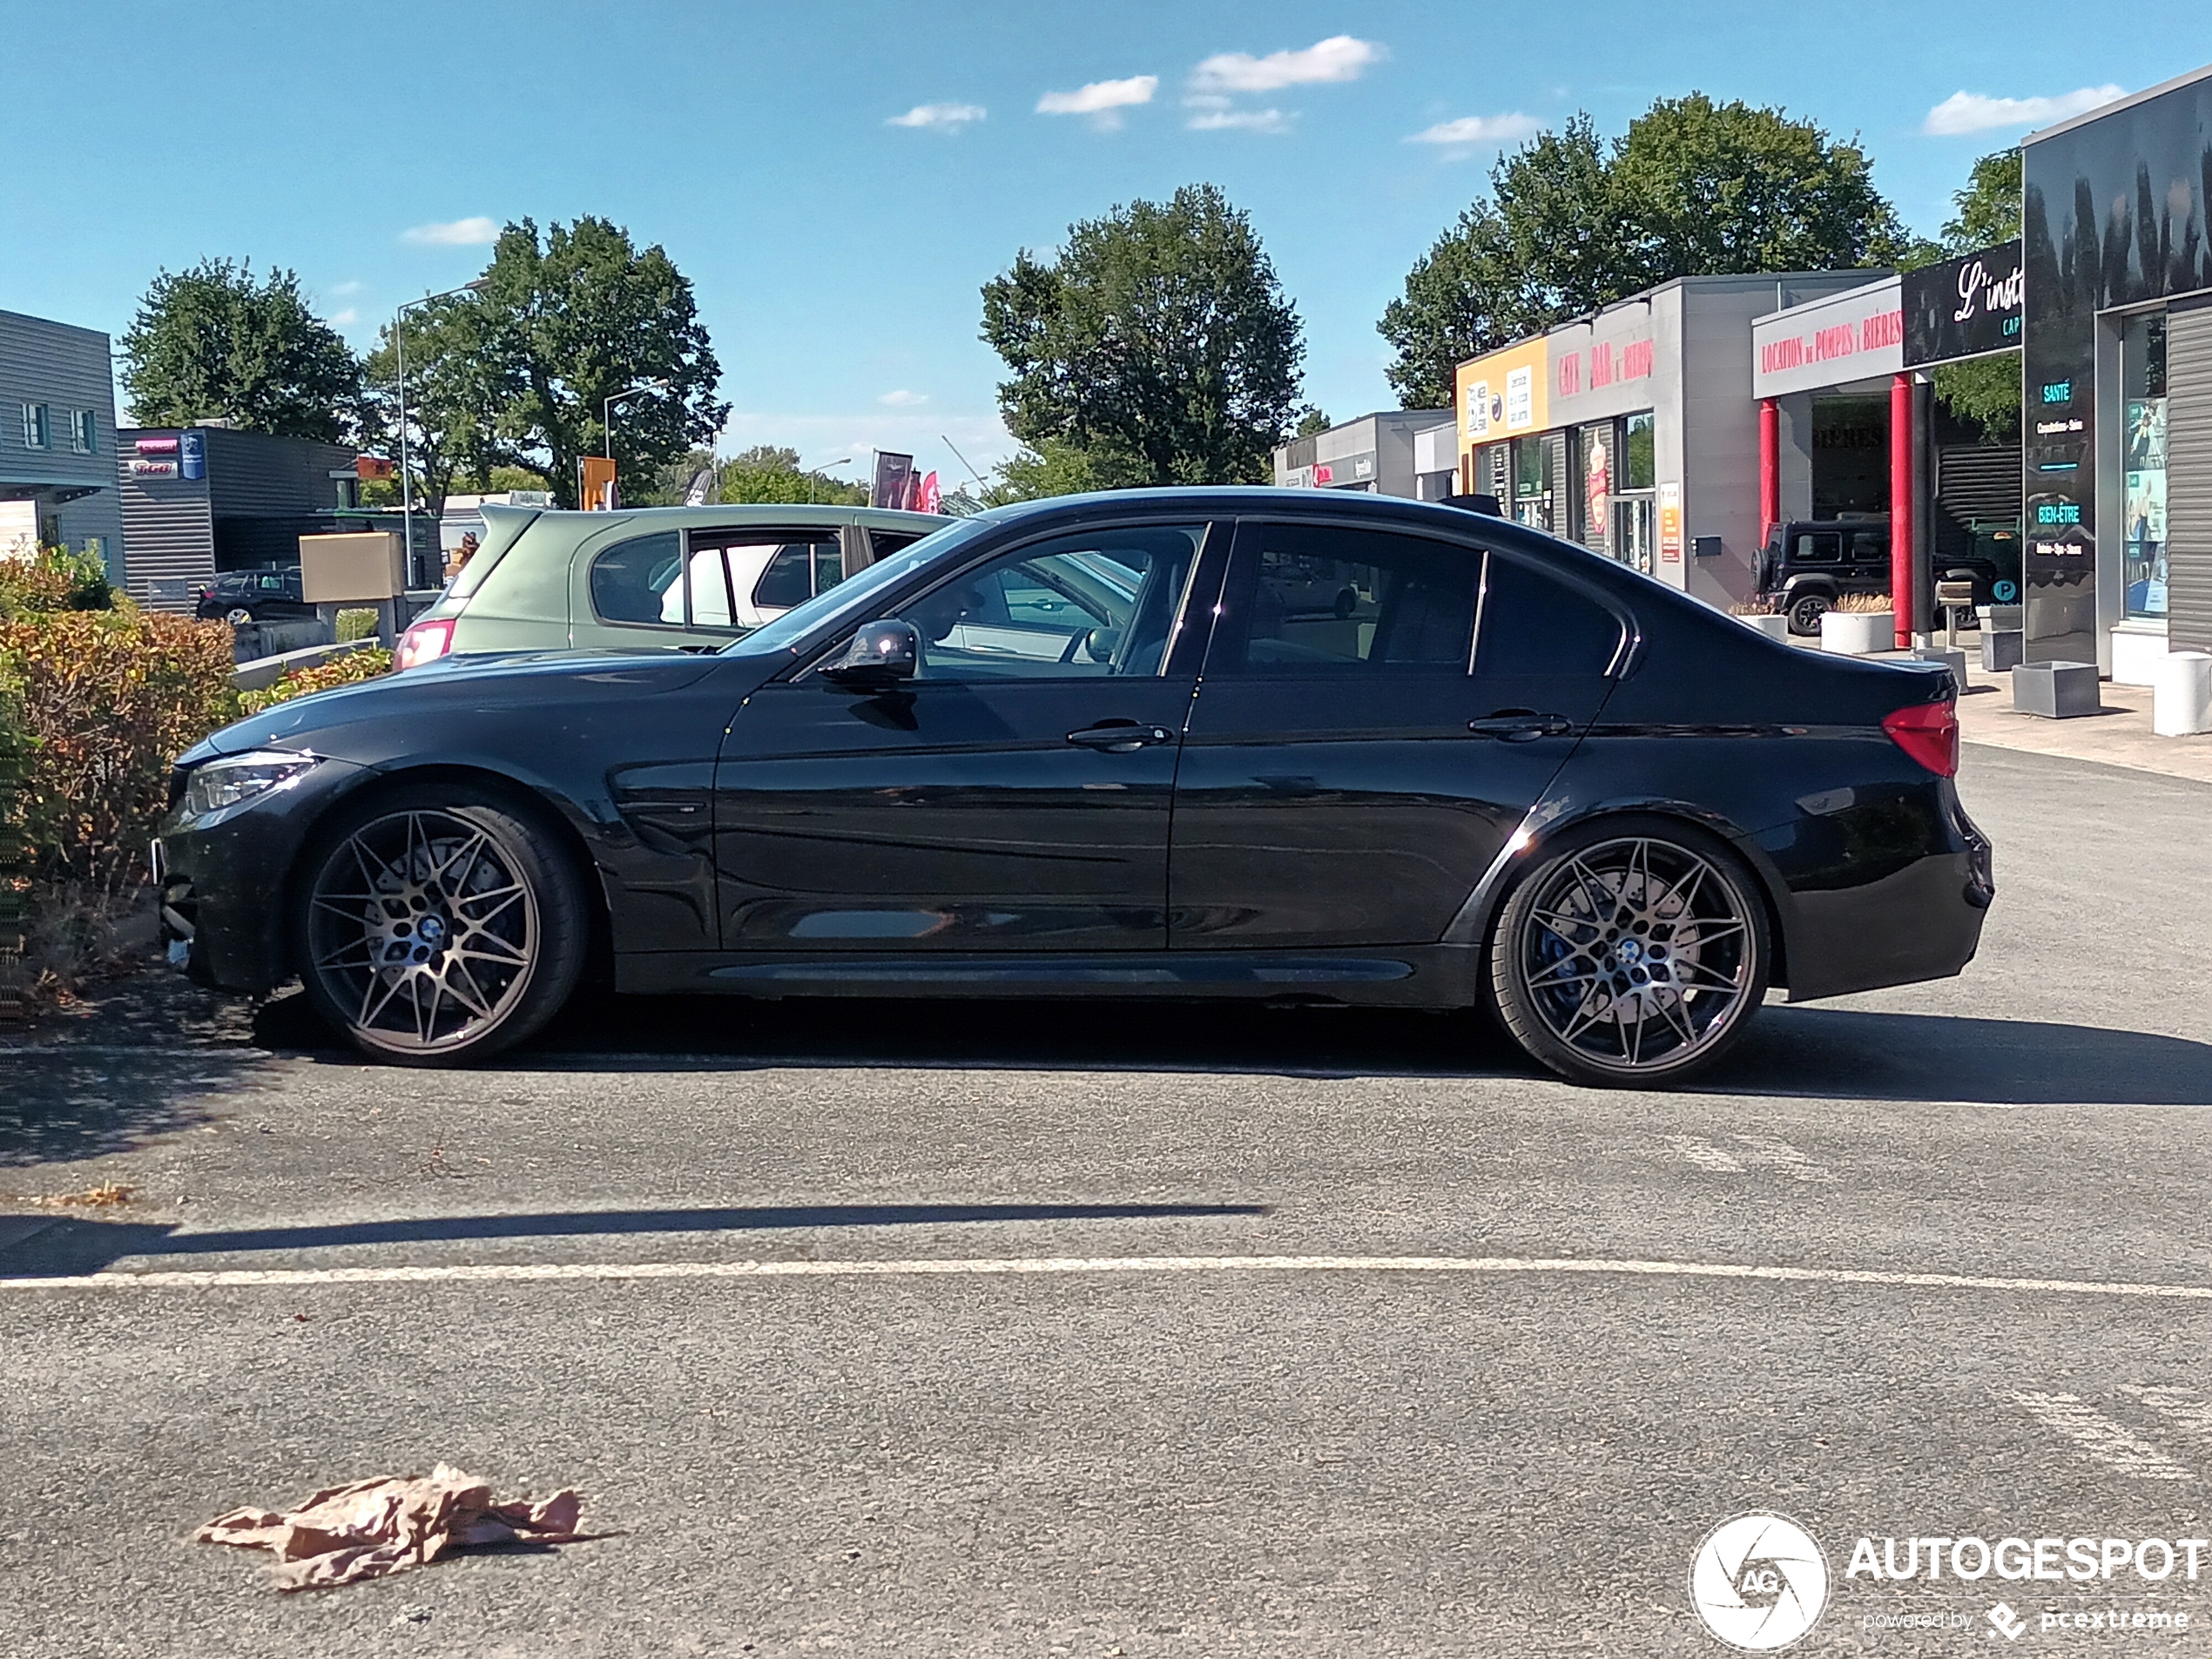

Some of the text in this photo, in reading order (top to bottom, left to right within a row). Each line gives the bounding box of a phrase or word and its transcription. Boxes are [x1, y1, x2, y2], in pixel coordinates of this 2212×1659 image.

[1762, 336, 1803, 374] LOCATION
[1815, 323, 1853, 361] POMPES
[1864, 307, 1904, 351] BIÈRES
[1592, 341, 1612, 389] BAR
[2044, 378, 2070, 402] SANTÉ
[2039, 502, 2080, 523] BIEN-ÊTRE
[2001, 583, 2011, 597] P
